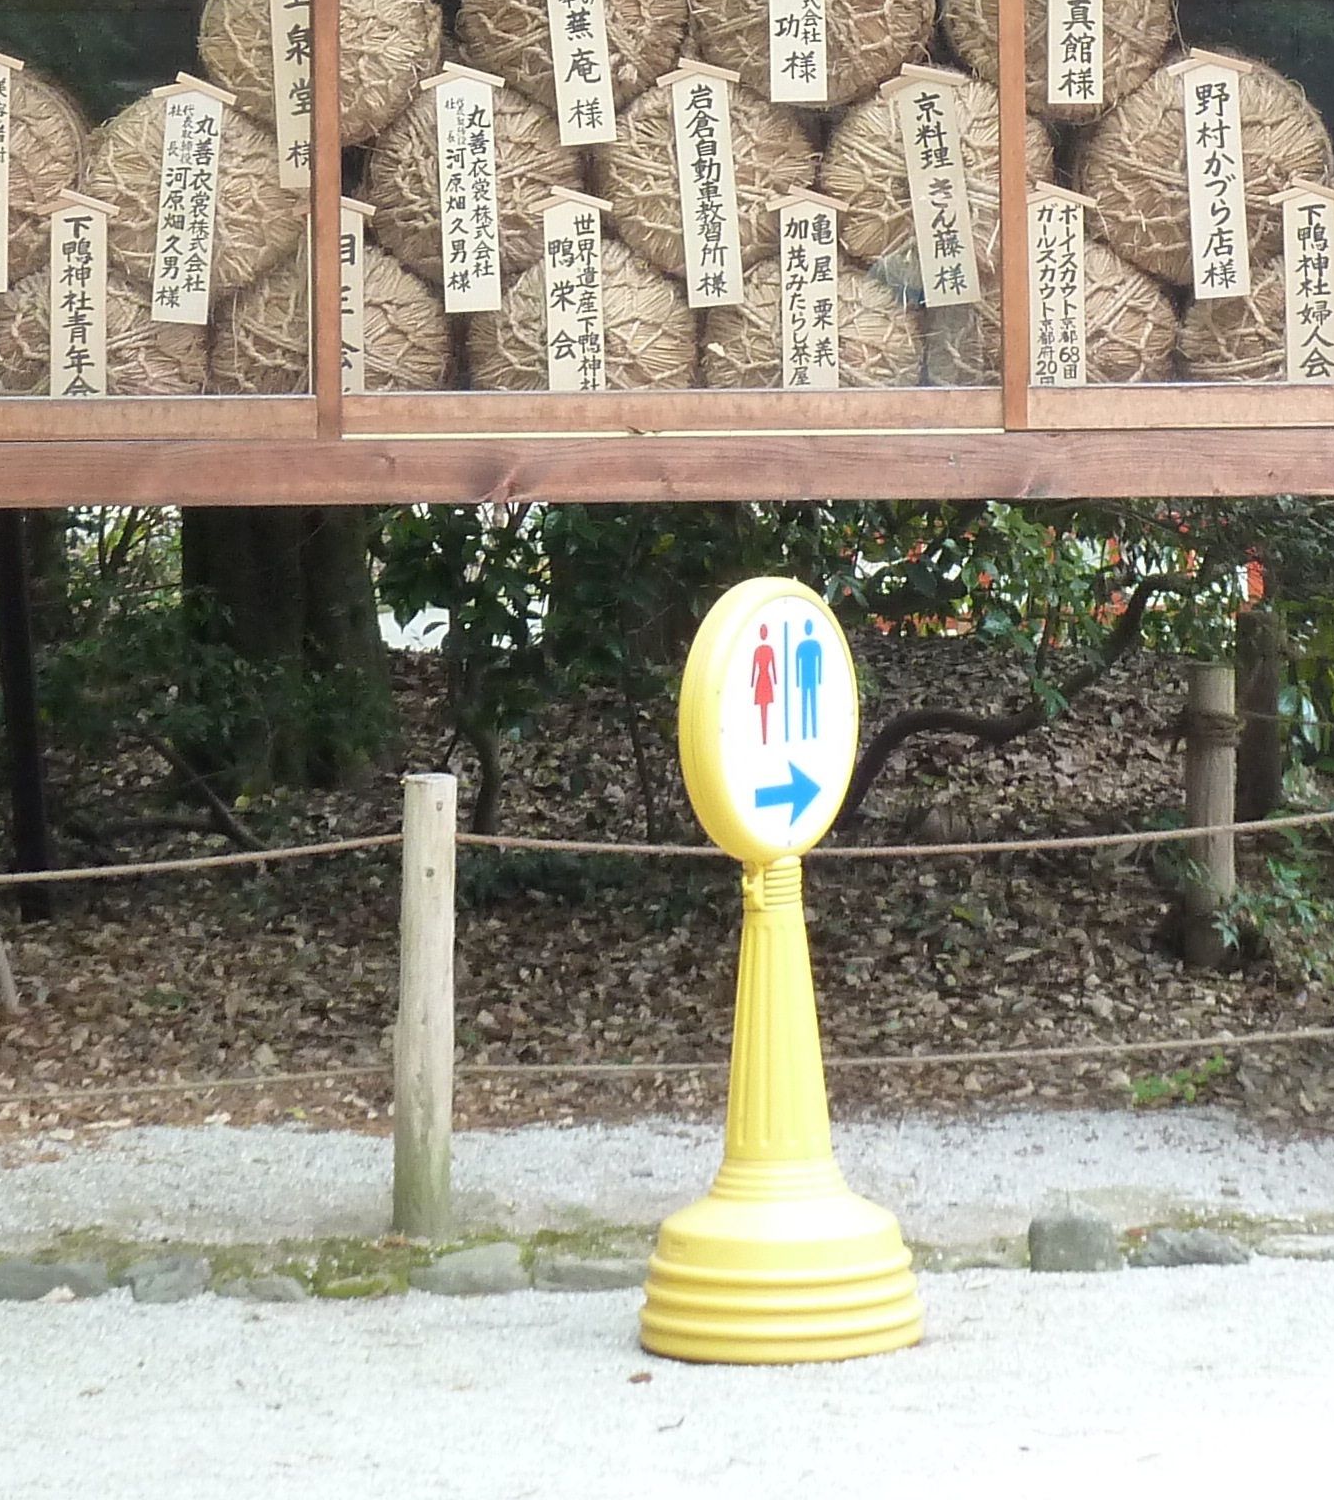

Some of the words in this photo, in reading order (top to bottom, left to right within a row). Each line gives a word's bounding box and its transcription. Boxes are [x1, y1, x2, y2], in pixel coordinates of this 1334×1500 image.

[181, 114, 219, 293] 丸善衣裳株式会社
[465, 104, 495, 279] 丸善衣裳株式会社
[685, 83, 728, 298] 岩倉自動車教習所様
[1194, 82, 1237, 289] 野村かづら店様
[548, 236, 577, 361] 鴨栄会
[784, 217, 812, 386] 加茂みたらし茶屋
